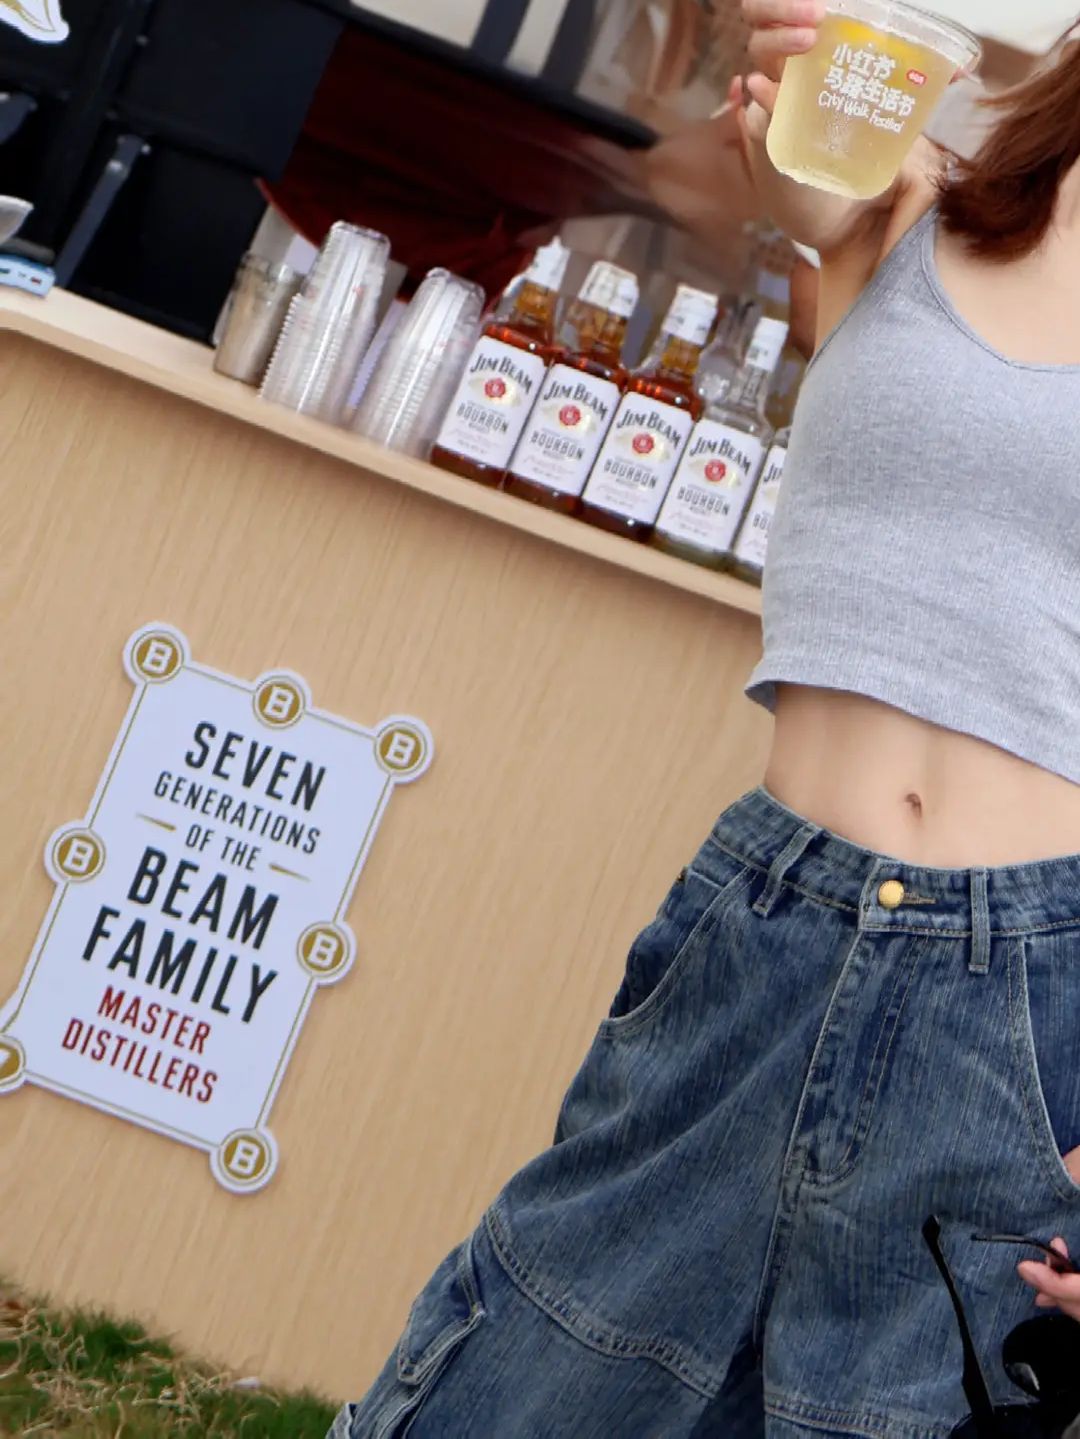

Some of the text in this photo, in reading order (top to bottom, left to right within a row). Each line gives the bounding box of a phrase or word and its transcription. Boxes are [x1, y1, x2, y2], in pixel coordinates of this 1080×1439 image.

[142, 639, 172, 674] B
[263, 685, 294, 720] B
[185, 721, 326, 812] SEVEN
[385, 732, 415, 767] B
[153, 770, 321, 856] GENERATIONS
[62, 838, 94, 872] B
[186, 823, 261, 871] OF THE
[128, 846, 278, 950] BEAM
[82, 905, 278, 1024] FAMILY
[308, 933, 340, 968] B
[97, 984, 212, 1054] MASTER
[62, 1017, 219, 1104] DISTILLERS
[231, 1139, 262, 1175] B
